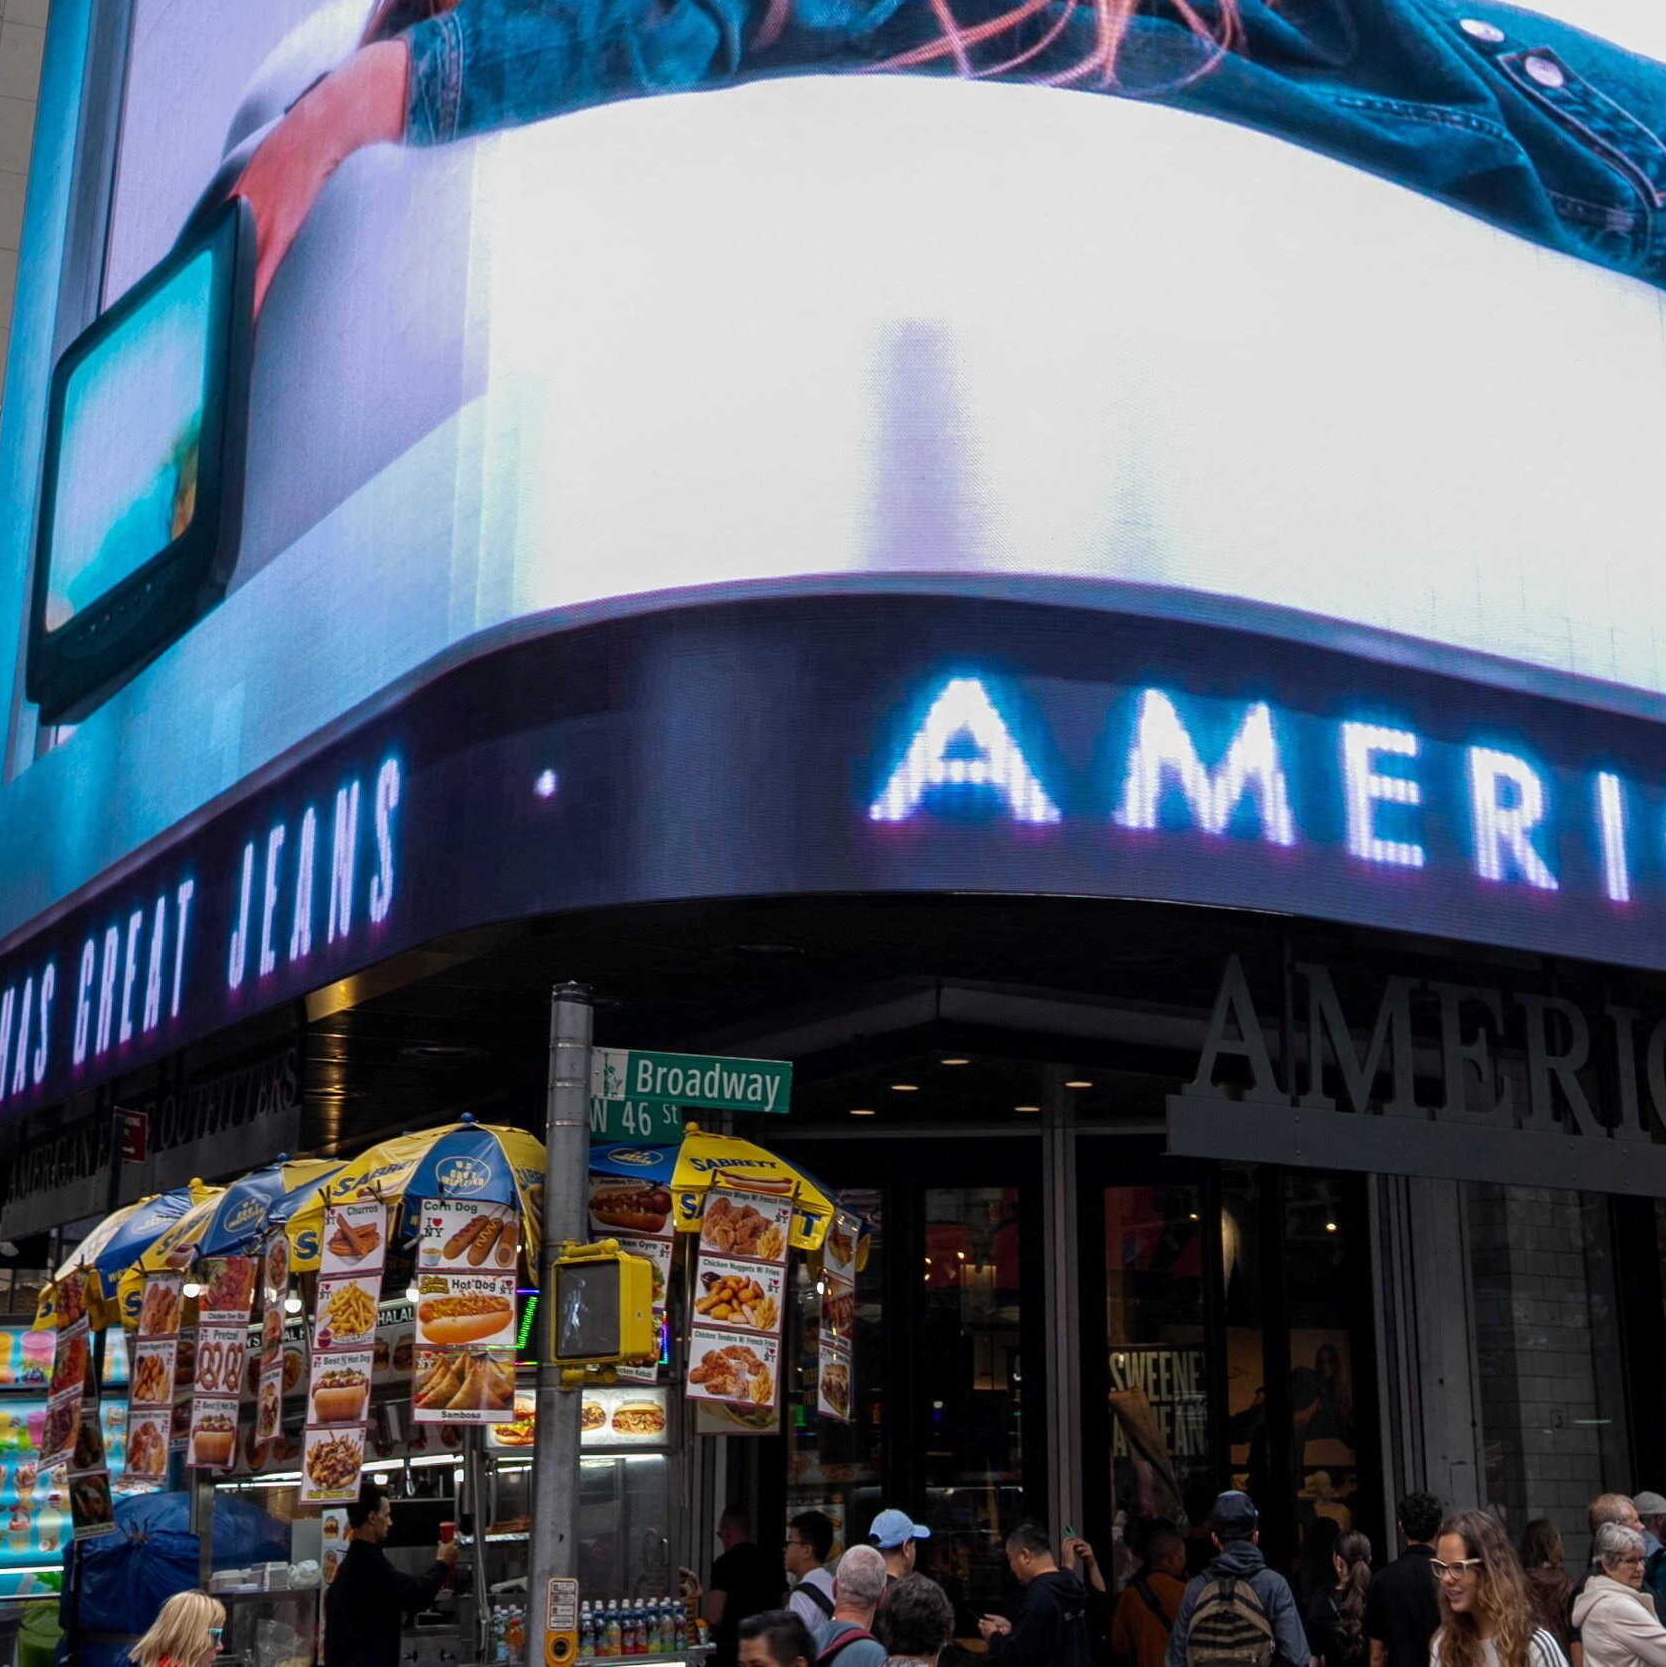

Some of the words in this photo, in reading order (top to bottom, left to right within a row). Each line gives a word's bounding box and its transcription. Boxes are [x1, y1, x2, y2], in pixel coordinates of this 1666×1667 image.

[73, 879, 195, 1067] GREAT
[229, 758, 401, 990] JEANS
[636, 1059, 781, 1112] Broadway
[160, 1046, 299, 1150] OUTFITTERS
[590, 1099, 608, 1133] W
[622, 1101, 652, 1136] 46
[662, 1103, 678, 1125] St
[688, 1157, 778, 1172] SABRETT
[733, 1191, 750, 1201] Wings
[346, 1205, 379, 1216] Churros
[424, 1201, 451, 1212] Corn
[455, 1202, 478, 1214] Dog
[424, 1228, 444, 1238] NY
[638, 1240, 658, 1251] Gyro
[703, 1259, 728, 1269] Chicken
[729, 1262, 755, 1274] Nuggets
[765, 1267, 781, 1277] Fries
[451, 1279, 471, 1290] Hot
[474, 1279, 496, 1292] Dog
[378, 1308, 415, 1327] HALAL
[213, 1329, 239, 1342] Pretzel
[694, 1331, 717, 1340] Chicken
[717, 1332, 738, 1342] Tenders
[746, 1337, 763, 1346] French
[764, 1340, 777, 1348] Fries
[323, 1355, 340, 1366] Best
[347, 1355, 359, 1364] Hot
[1108, 1351, 1206, 1402] SWEENE
[441, 1410, 481, 1419] Sambosa
